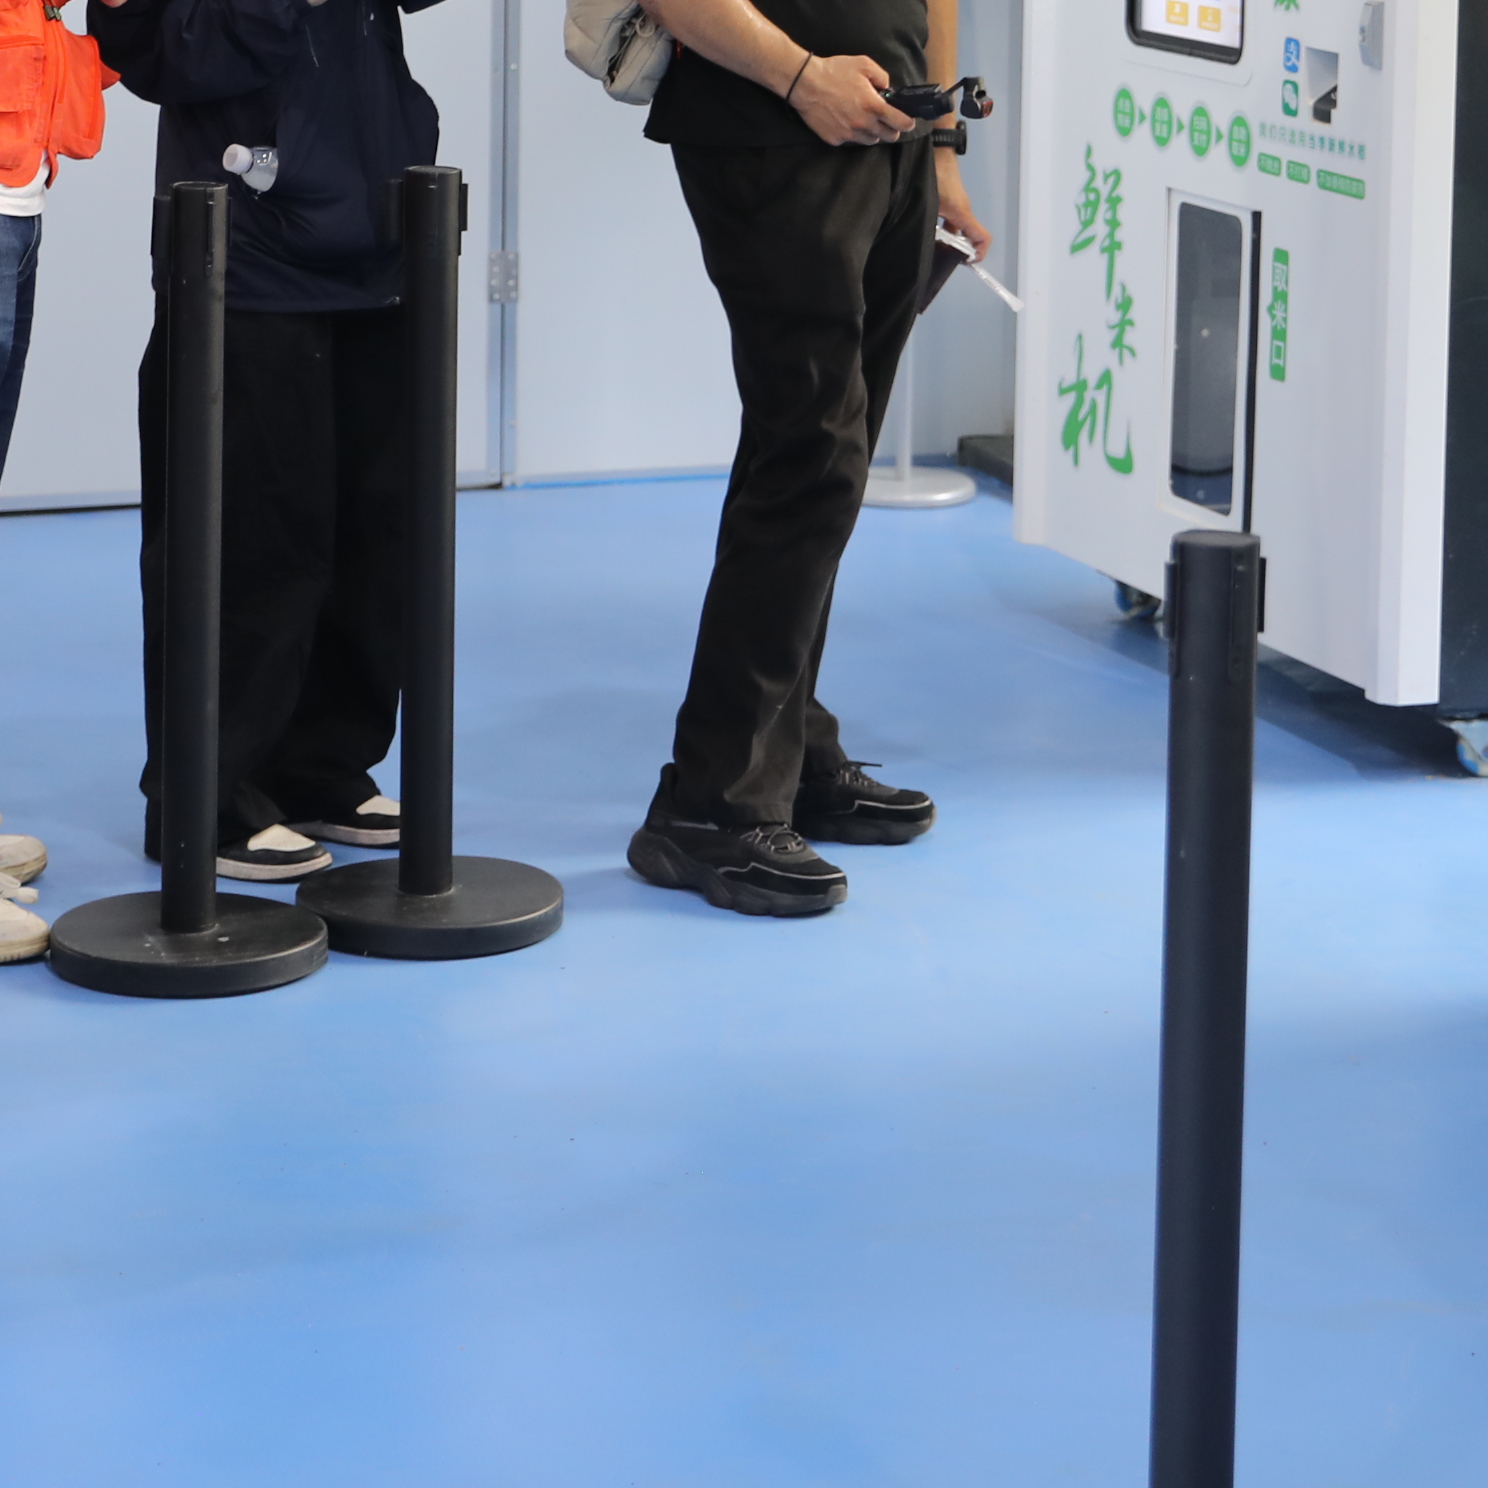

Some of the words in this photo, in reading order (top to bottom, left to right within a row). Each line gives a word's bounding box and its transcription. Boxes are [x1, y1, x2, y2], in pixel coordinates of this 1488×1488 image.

[1058, 142, 1136, 475] 鲜米机
[1271, 261, 1288, 367] 取米口
